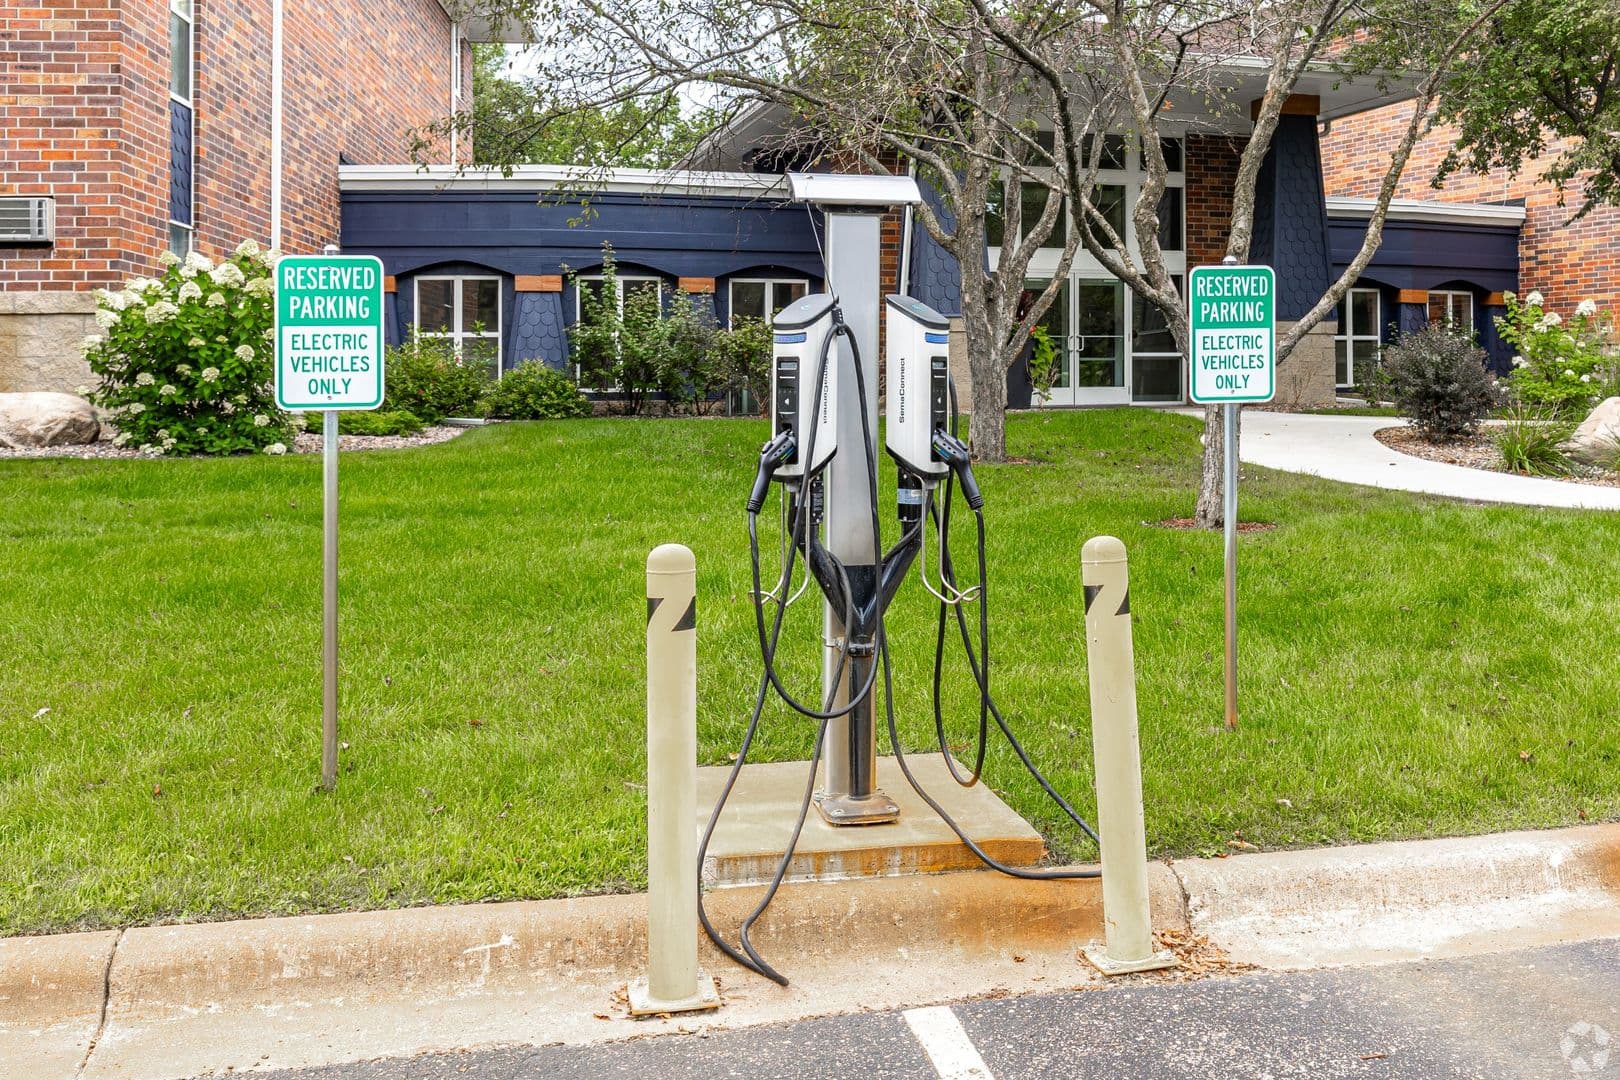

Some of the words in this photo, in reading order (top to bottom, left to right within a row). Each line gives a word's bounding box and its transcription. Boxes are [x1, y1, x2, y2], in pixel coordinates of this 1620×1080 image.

[284, 266, 376, 290] RESERVED
[1196, 275, 1268, 297] RESERVED
[289, 295, 370, 319] PARKING
[1201, 301, 1264, 323] PARKING
[291, 334, 368, 350] ELECTRIC
[1202, 335, 1263, 350] ELECTRIC
[290, 356, 370, 373] VEHICLES
[1201, 354, 1264, 370] VEHICLES
[308, 378, 352, 395] ONLY
[1215, 374, 1250, 389] ONLY
